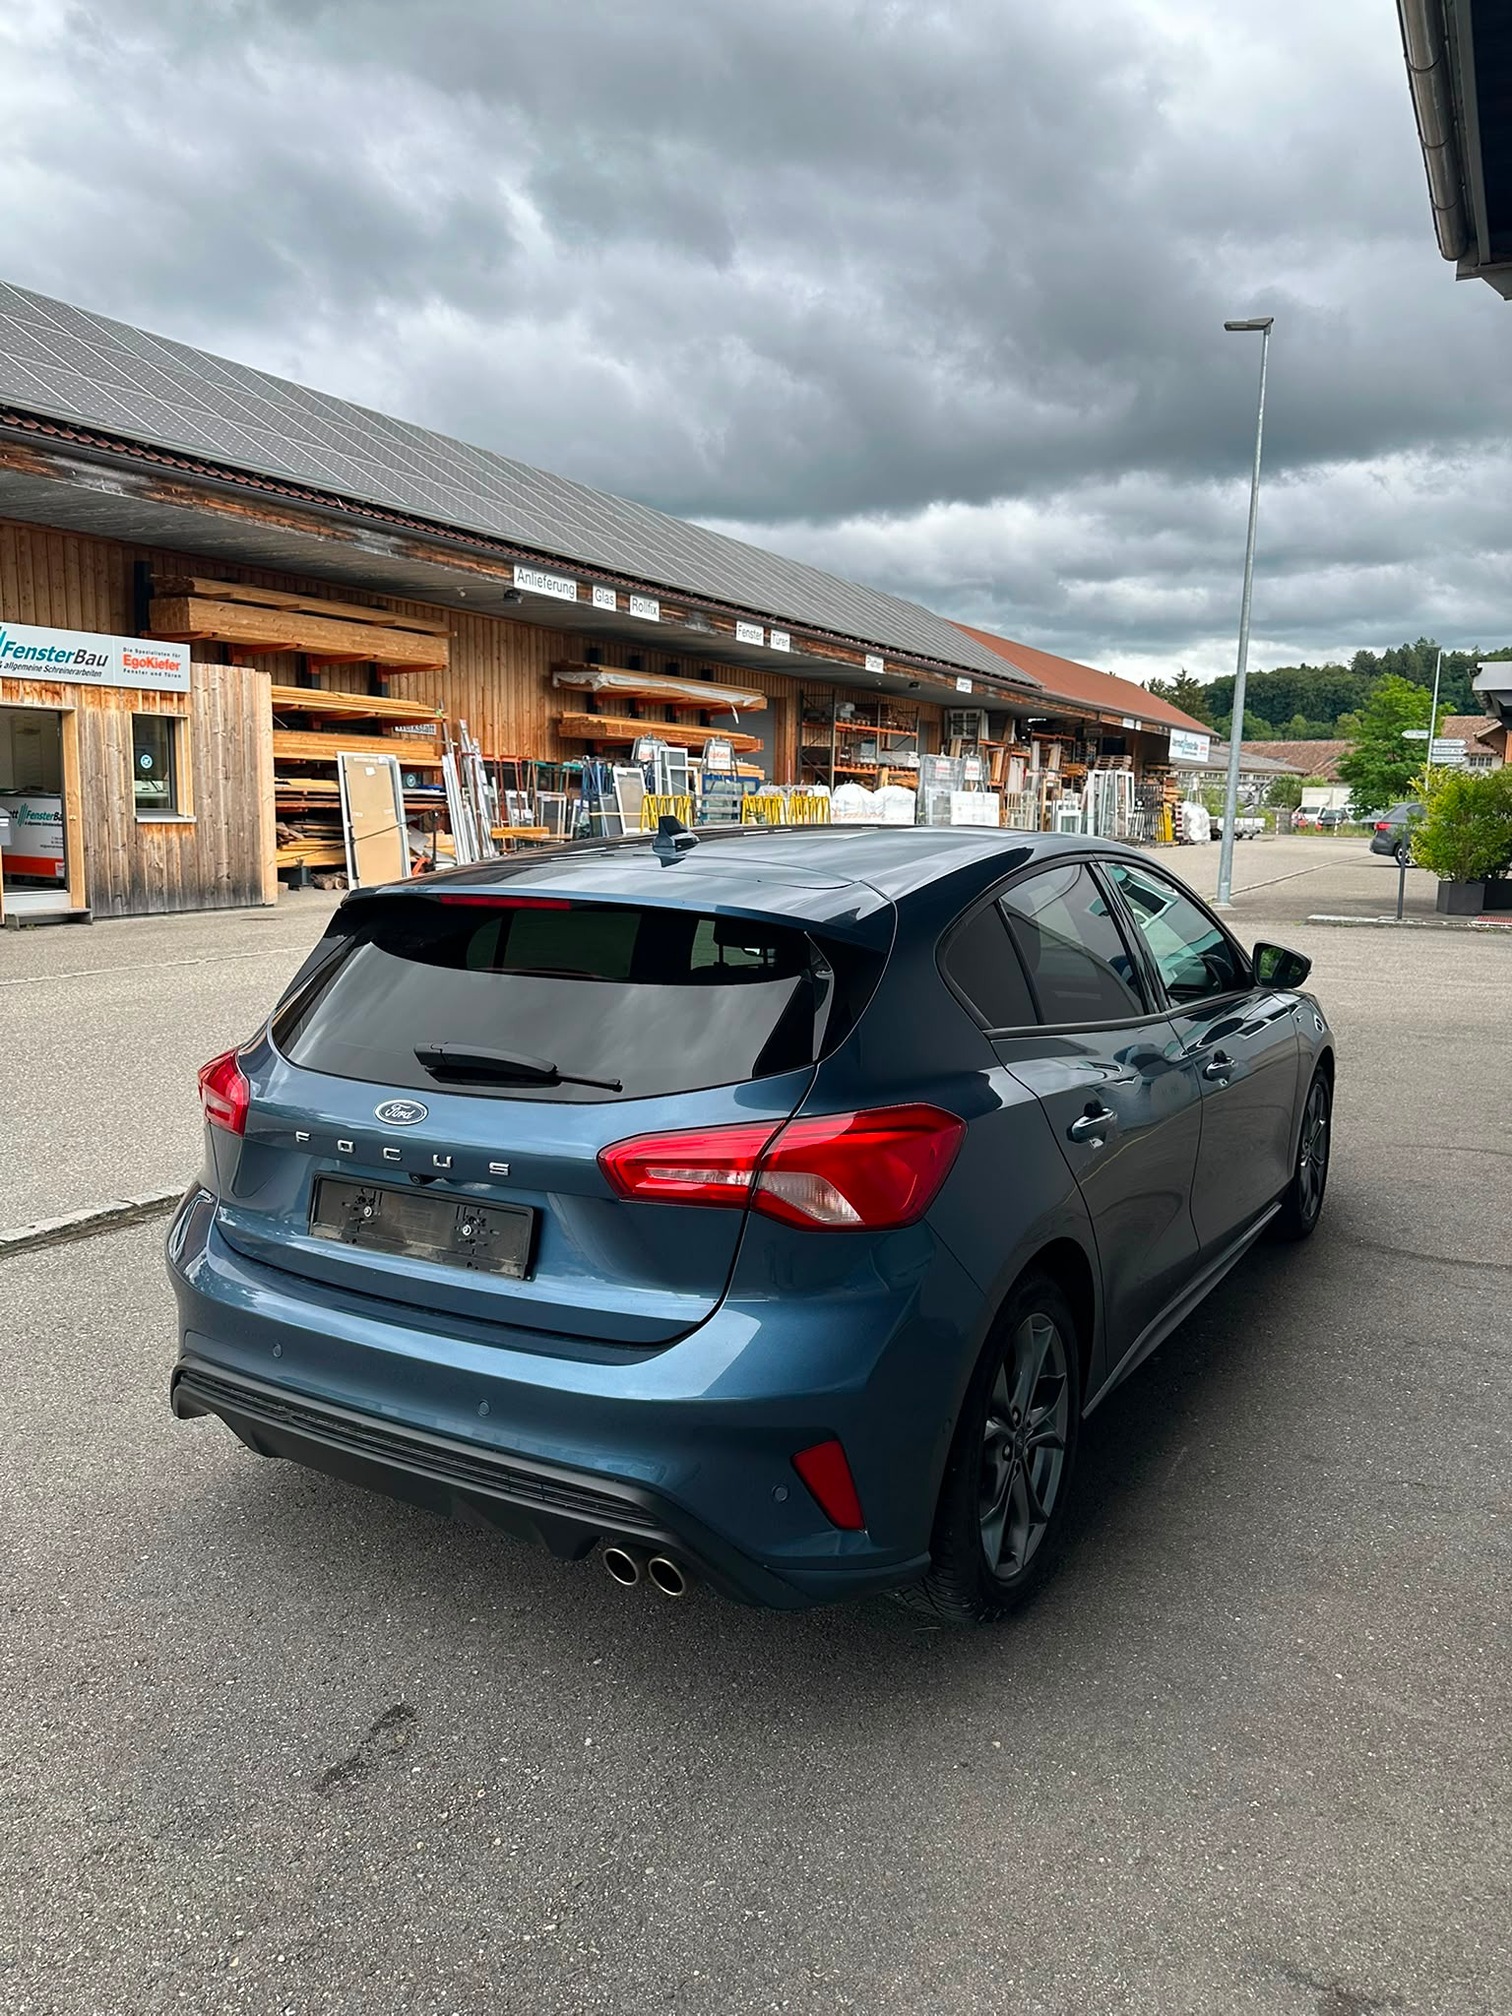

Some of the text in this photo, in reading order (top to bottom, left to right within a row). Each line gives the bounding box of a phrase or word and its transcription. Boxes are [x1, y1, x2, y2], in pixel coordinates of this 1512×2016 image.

[516, 568, 575, 599] Anlieferung
[594, 588, 615, 606] Glas
[632, 597, 658, 616] Rollfix
[738, 623, 763, 641] Fenster
[772, 632, 789, 647] Türen
[1, 640, 109, 668] FensterBau
[122, 653, 182, 671] EgoKiefer
[4, 661, 43, 672] allgemeine
[43, 665, 102, 678] Schreinerarbeiten
[27, 811, 63, 822] FensterBa
[385, 1104, 415, 1119] Ford
[295, 1131, 510, 1176] FOCUS
